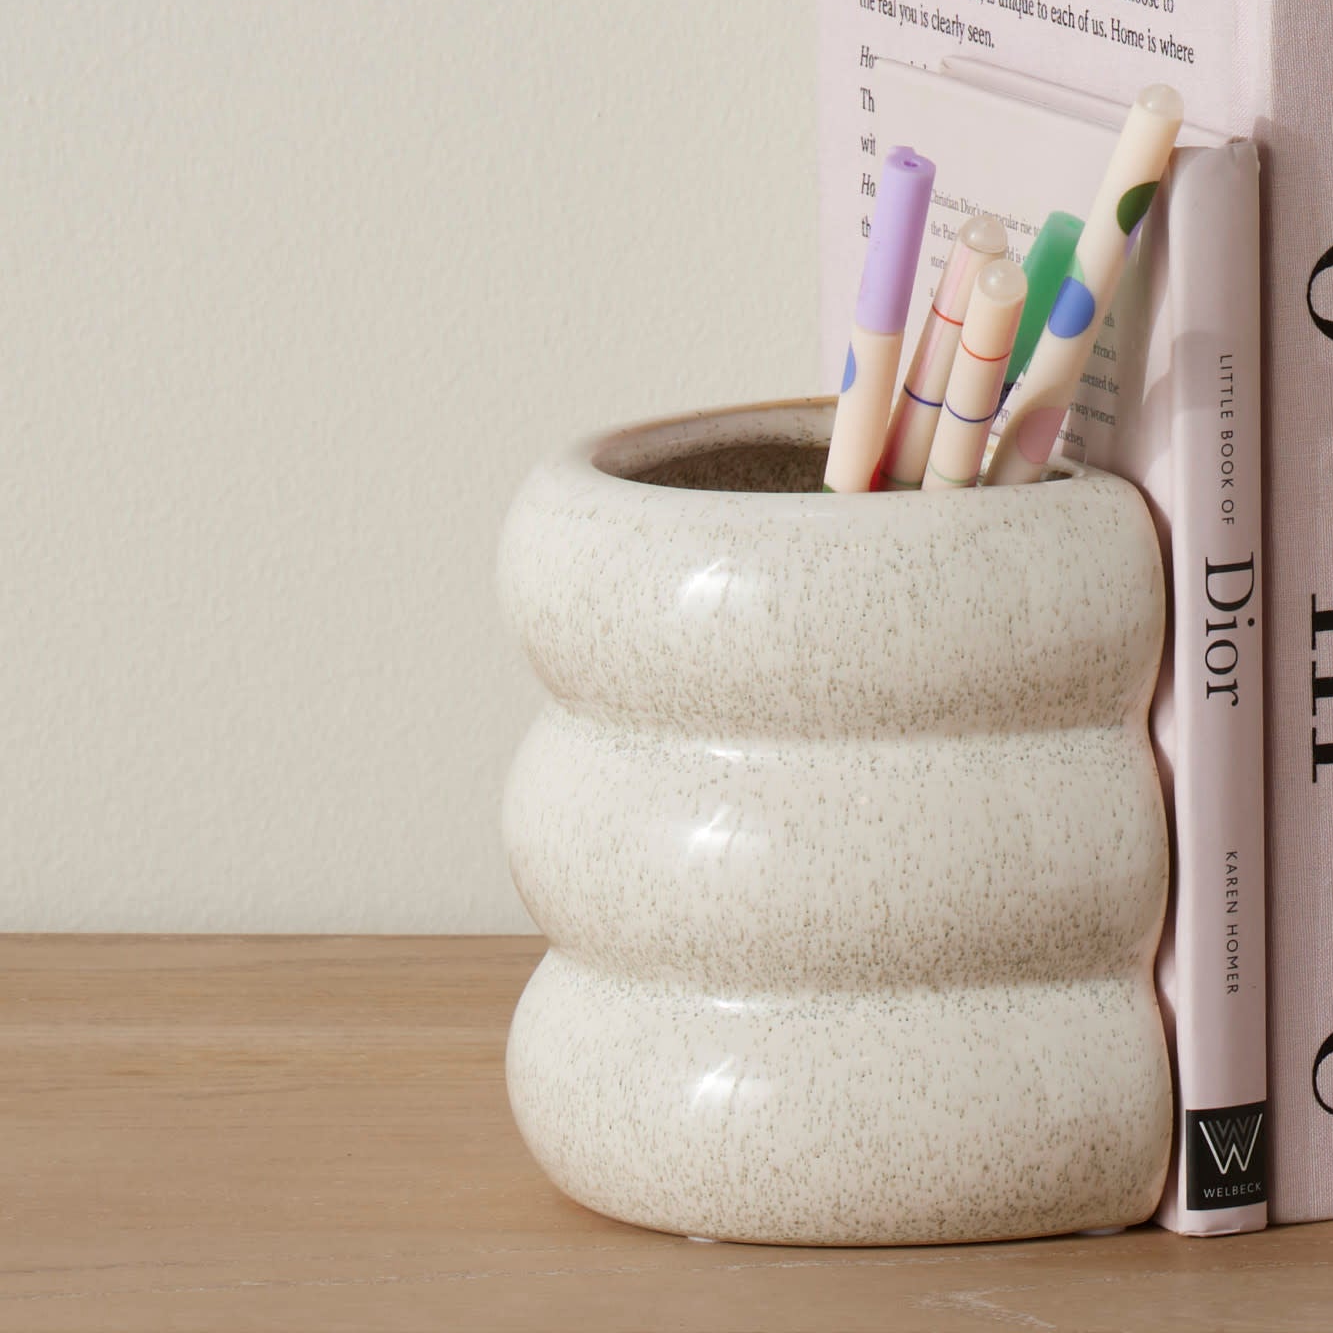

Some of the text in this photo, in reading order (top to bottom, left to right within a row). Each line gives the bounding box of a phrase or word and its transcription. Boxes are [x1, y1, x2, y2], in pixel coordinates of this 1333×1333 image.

[860, 45, 876, 69] Ho
[899, 4, 917, 26] you
[920, 5, 929, 28] is
[931, 8, 965, 44] clearly
[968, 25, 994, 48] seen.
[1037, 0, 1048, 20] to
[1051, 5, 1075, 29] each
[1078, 9, 1089, 33] of
[1091, 19, 1107, 38] us.
[1111, 18, 1144, 49] Home
[1147, 28, 1157, 53] is
[1159, 34, 1194, 64] where
[1219, 354, 1235, 525] LITTLE BOOK OF
[1204, 551, 1255, 707] Dior
[1225, 850, 1239, 995] KAREN HOMER
[1203, 1181, 1262, 1199] WELBECK
